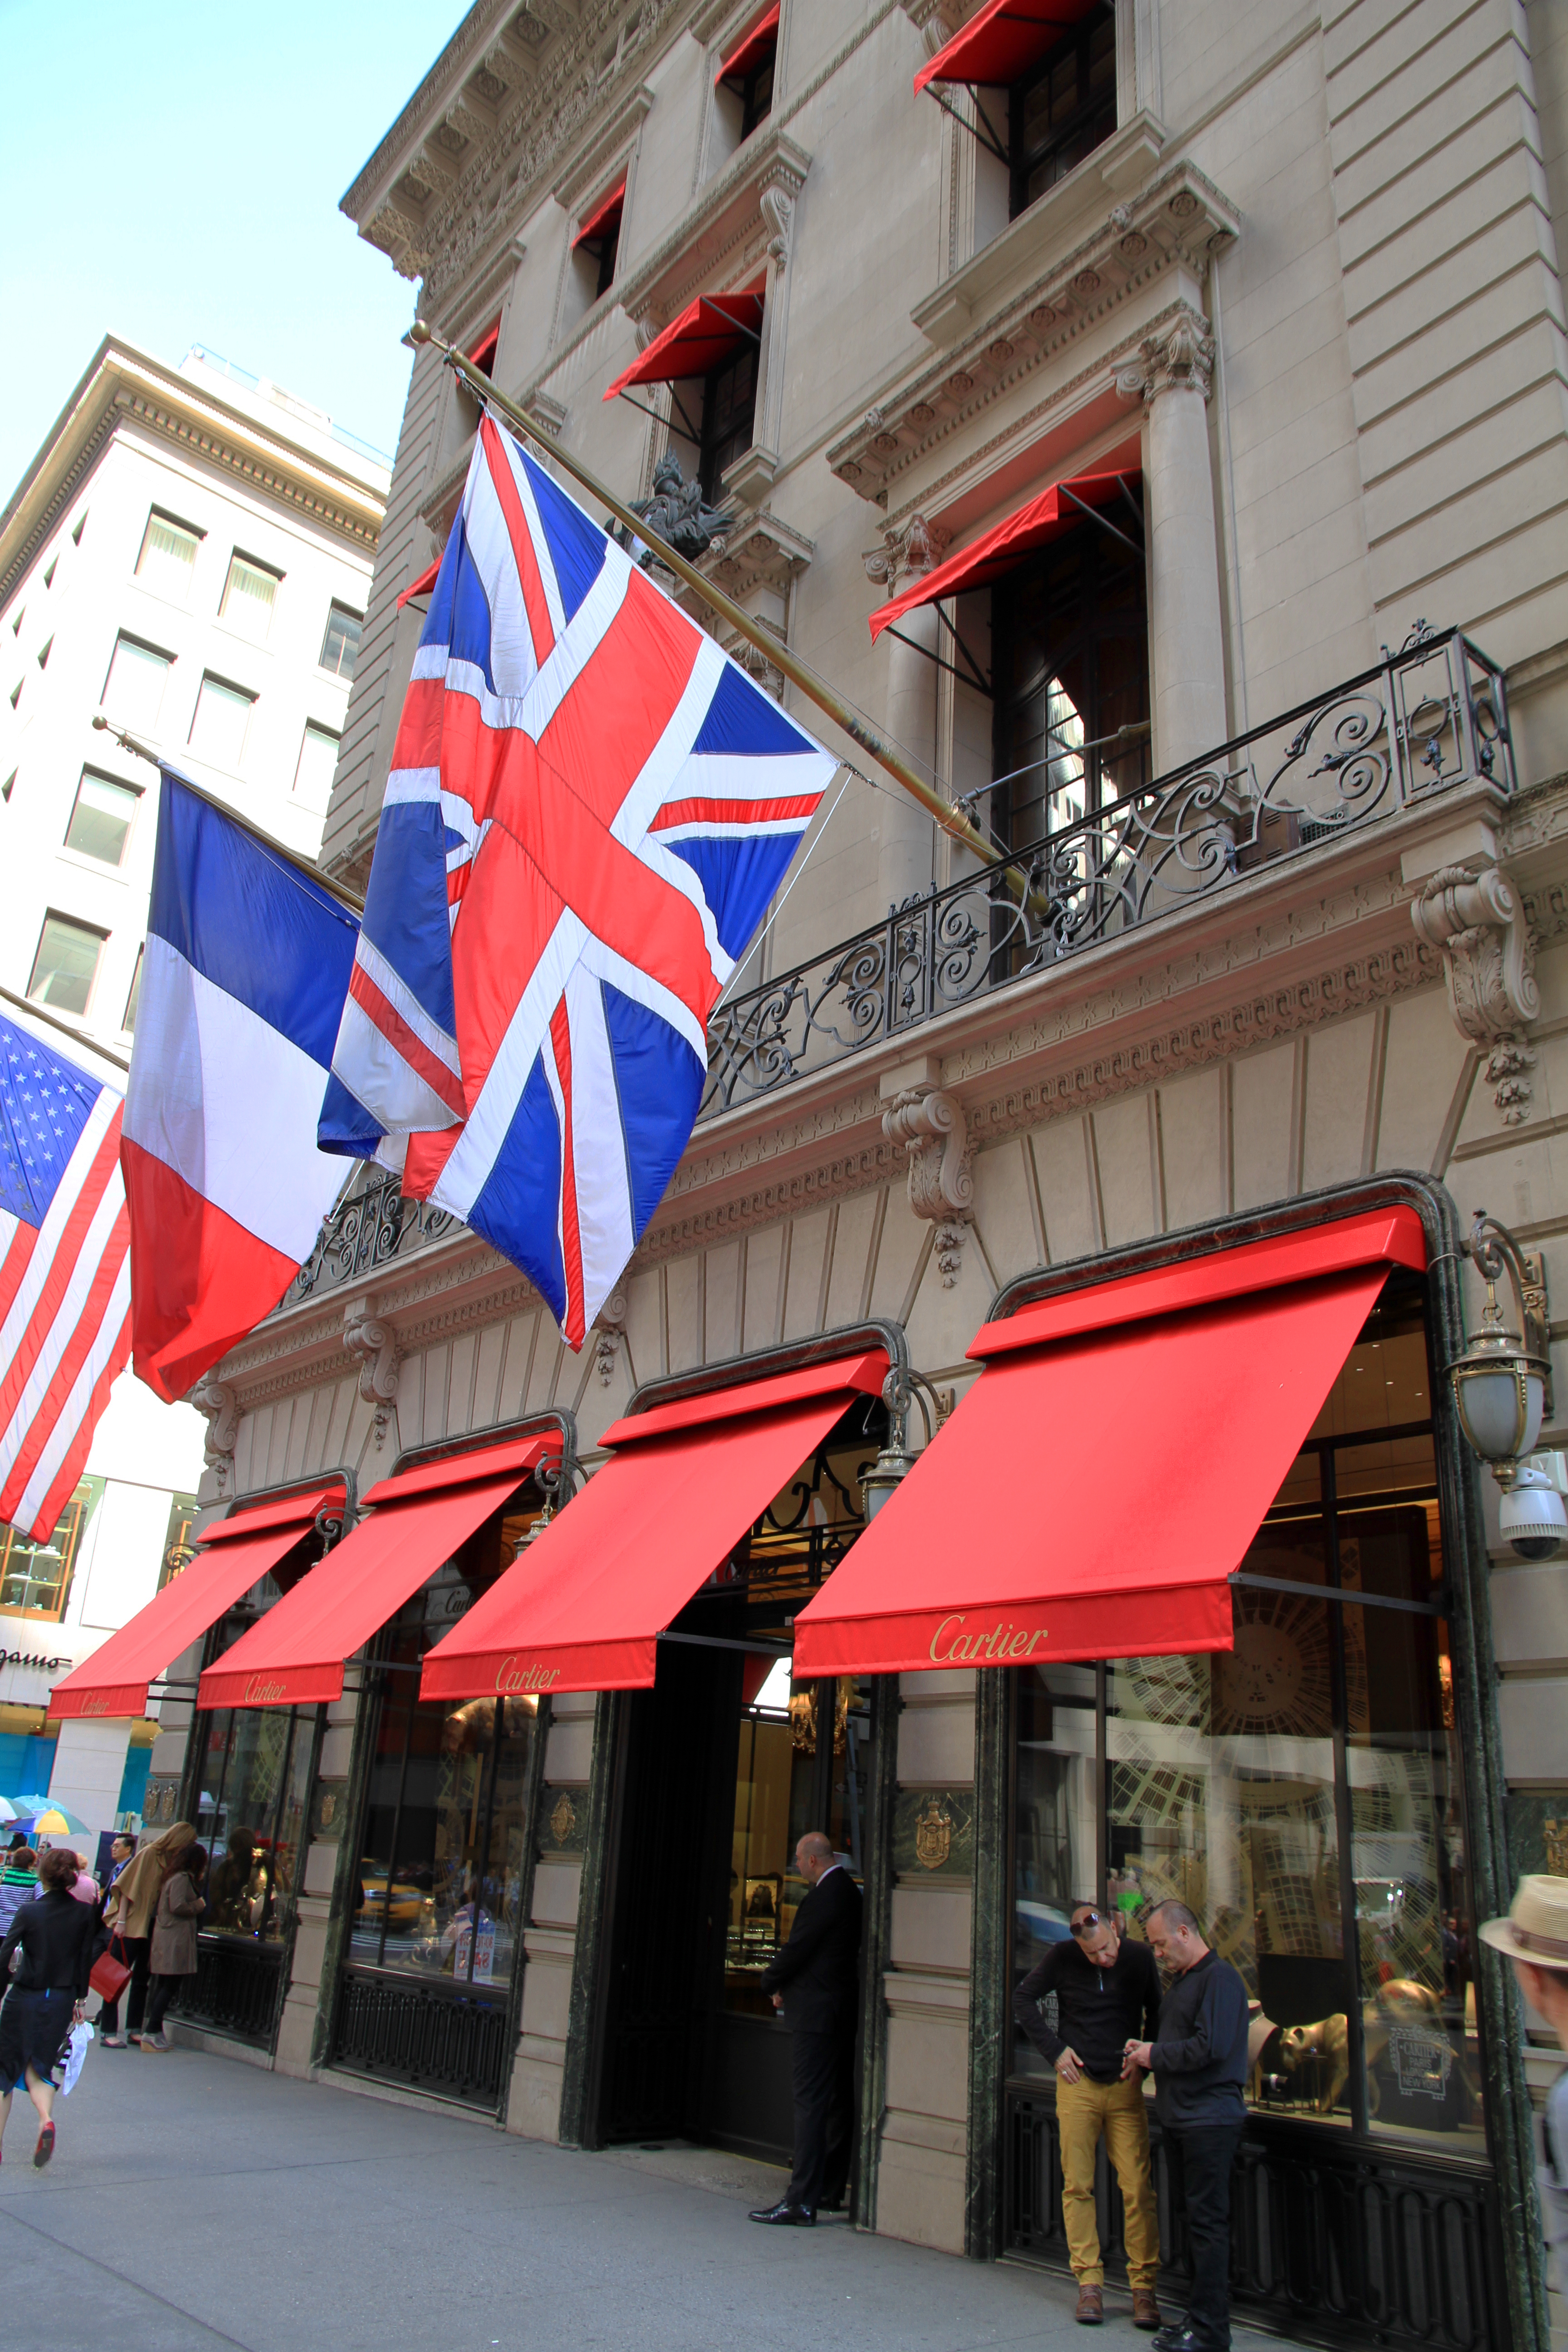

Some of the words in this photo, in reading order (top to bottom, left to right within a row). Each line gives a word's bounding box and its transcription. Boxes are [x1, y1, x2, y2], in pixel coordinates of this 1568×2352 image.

[930, 1615, 1048, 1662] Cartier
[495, 1656, 560, 1691] Cartier
[245, 1675, 286, 1702] Cartier
[80, 1692, 109, 1715] Cartier
[1409, 2057, 1432, 2069] PARIS
[1402, 2076, 1421, 2087] NEW
[1422, 2079, 1441, 2091] YORK
